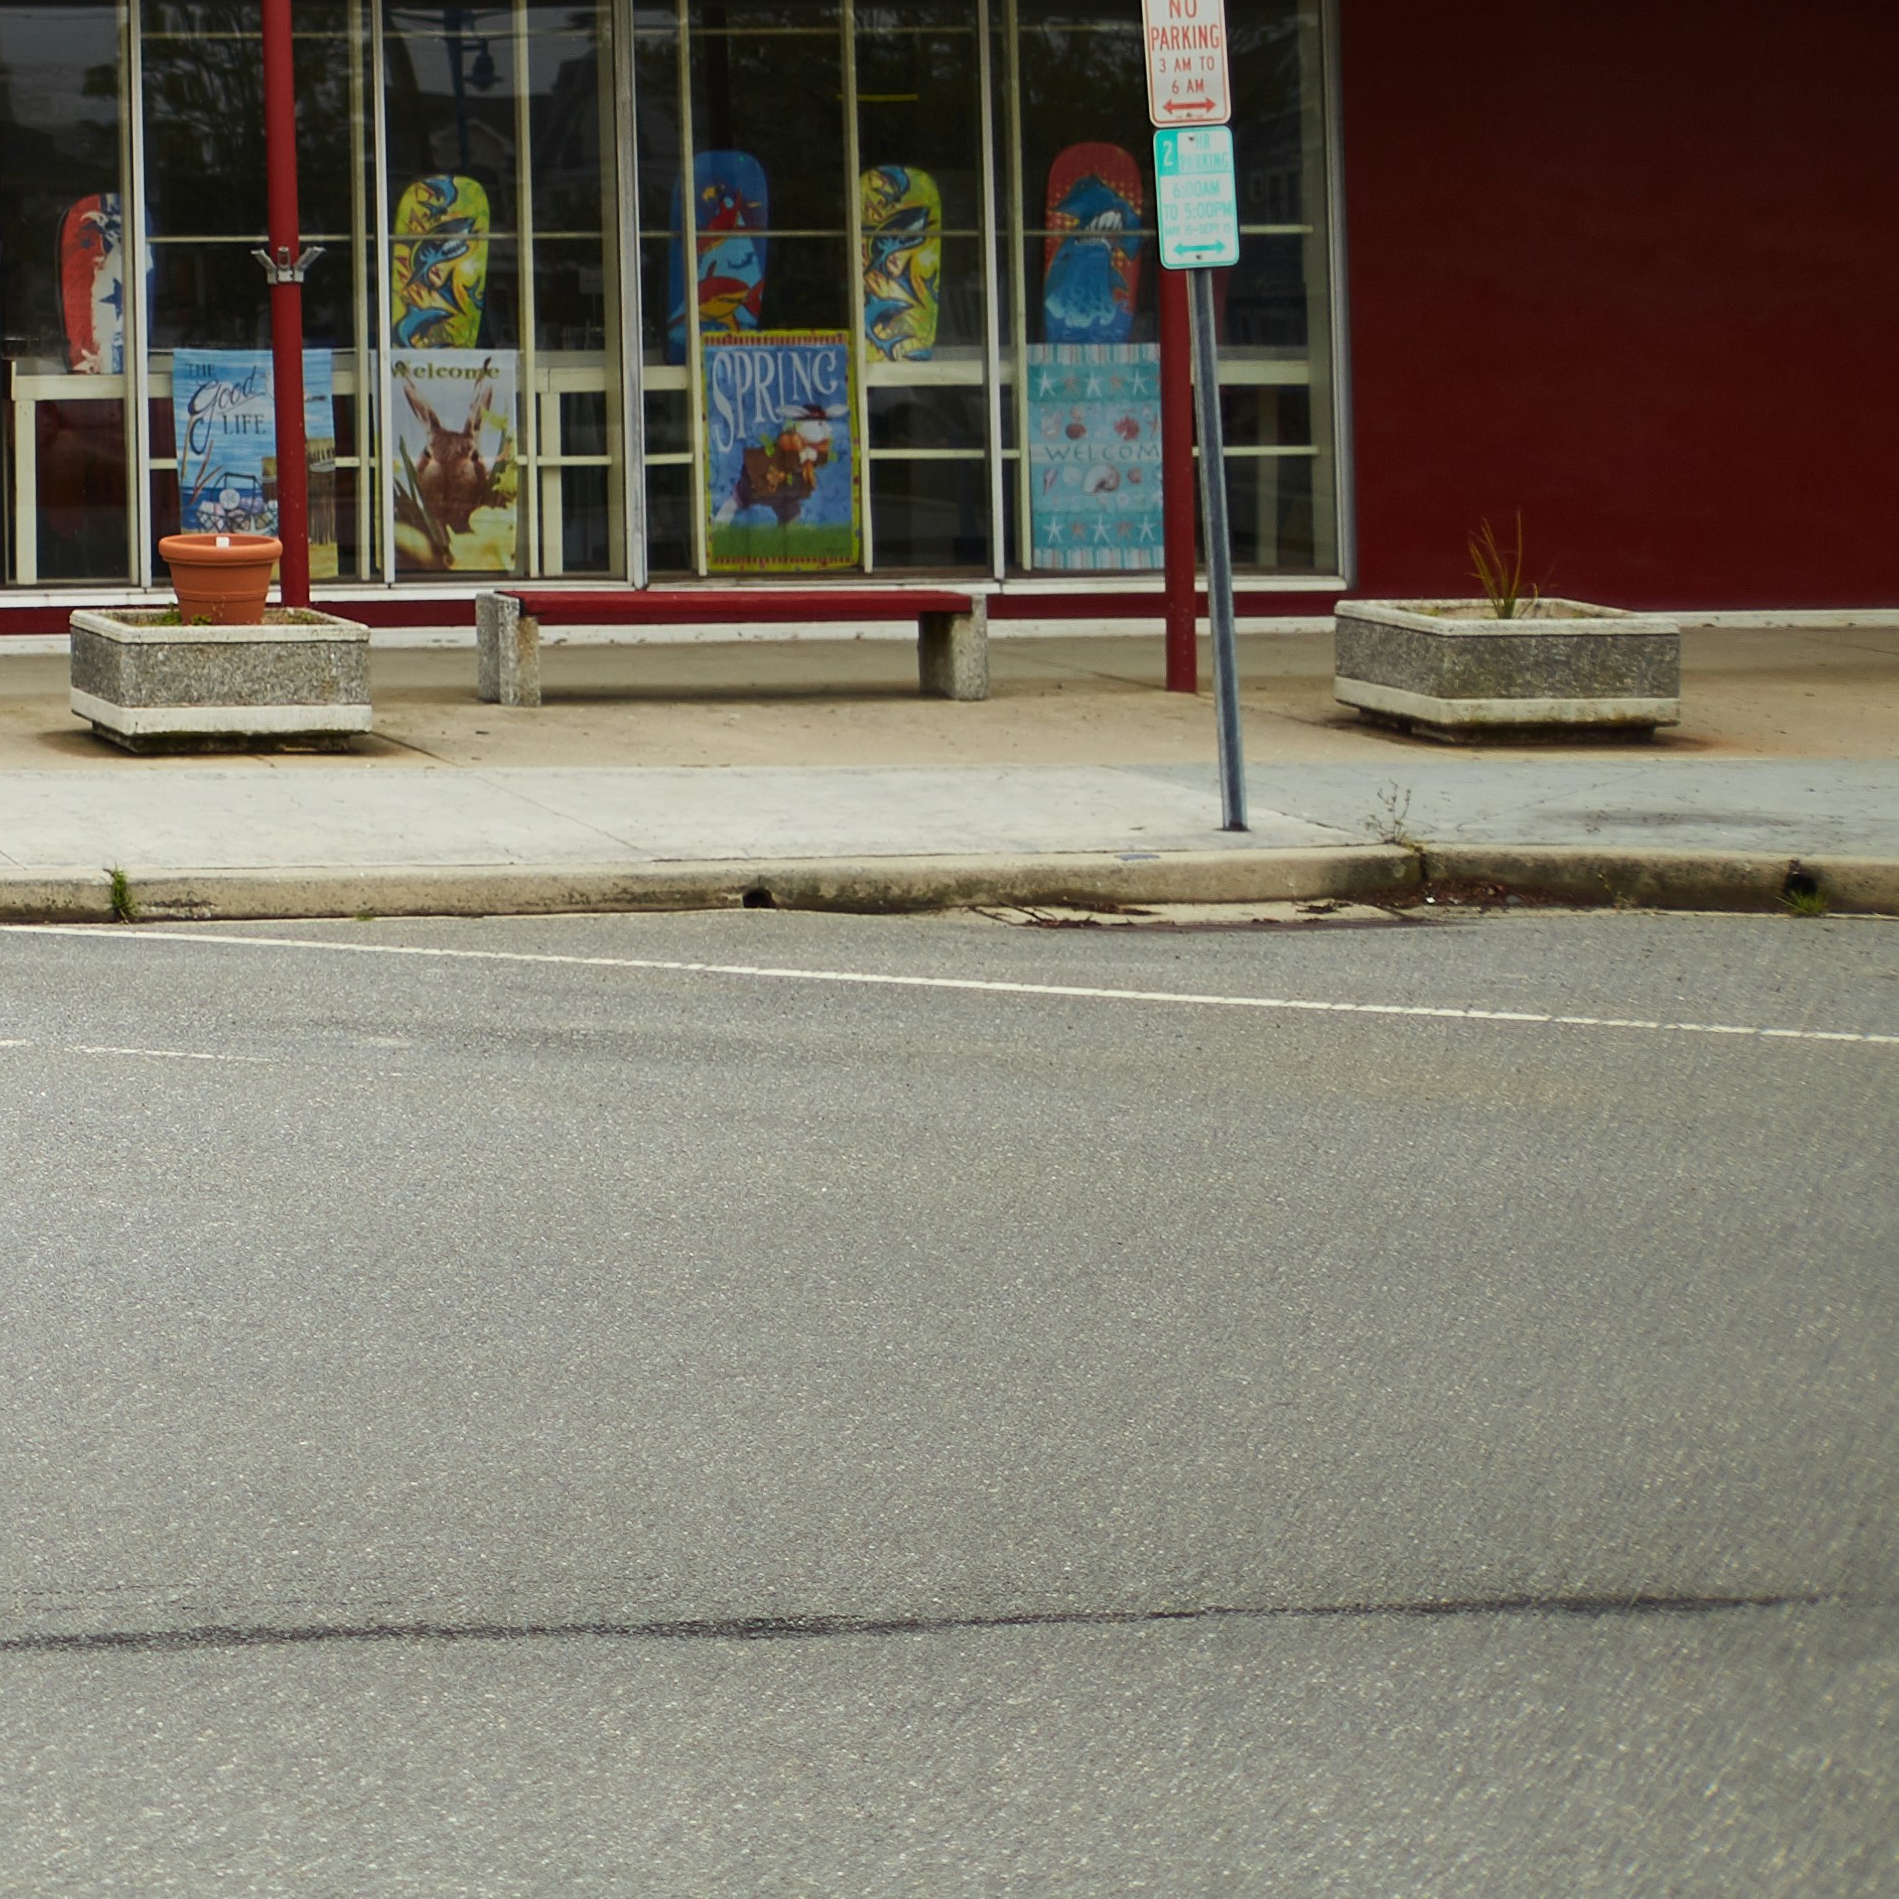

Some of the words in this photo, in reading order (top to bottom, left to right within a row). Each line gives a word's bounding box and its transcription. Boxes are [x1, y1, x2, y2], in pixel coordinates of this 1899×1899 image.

[1151, 24, 1220, 52] PARKING
[1159, 58, 1167, 73] 3
[1174, 57, 1192, 72] AM
[1200, 56, 1215, 71] TO
[1172, 80, 1179, 94] 6
[1187, 78, 1204, 94] AM
[1162, 140, 1174, 167] 2
[1180, 151, 1229, 171] PARKING
[1172, 180, 1220, 199] 6:00AM
[1163, 204, 1179, 221] TO
[1185, 202, 1232, 220] 5:00PM
[185, 363, 215, 378] THE
[391, 360, 500, 380] Welcome
[222, 413, 267, 435] LIFE
[1044, 444, 1161, 462] WELCOM
